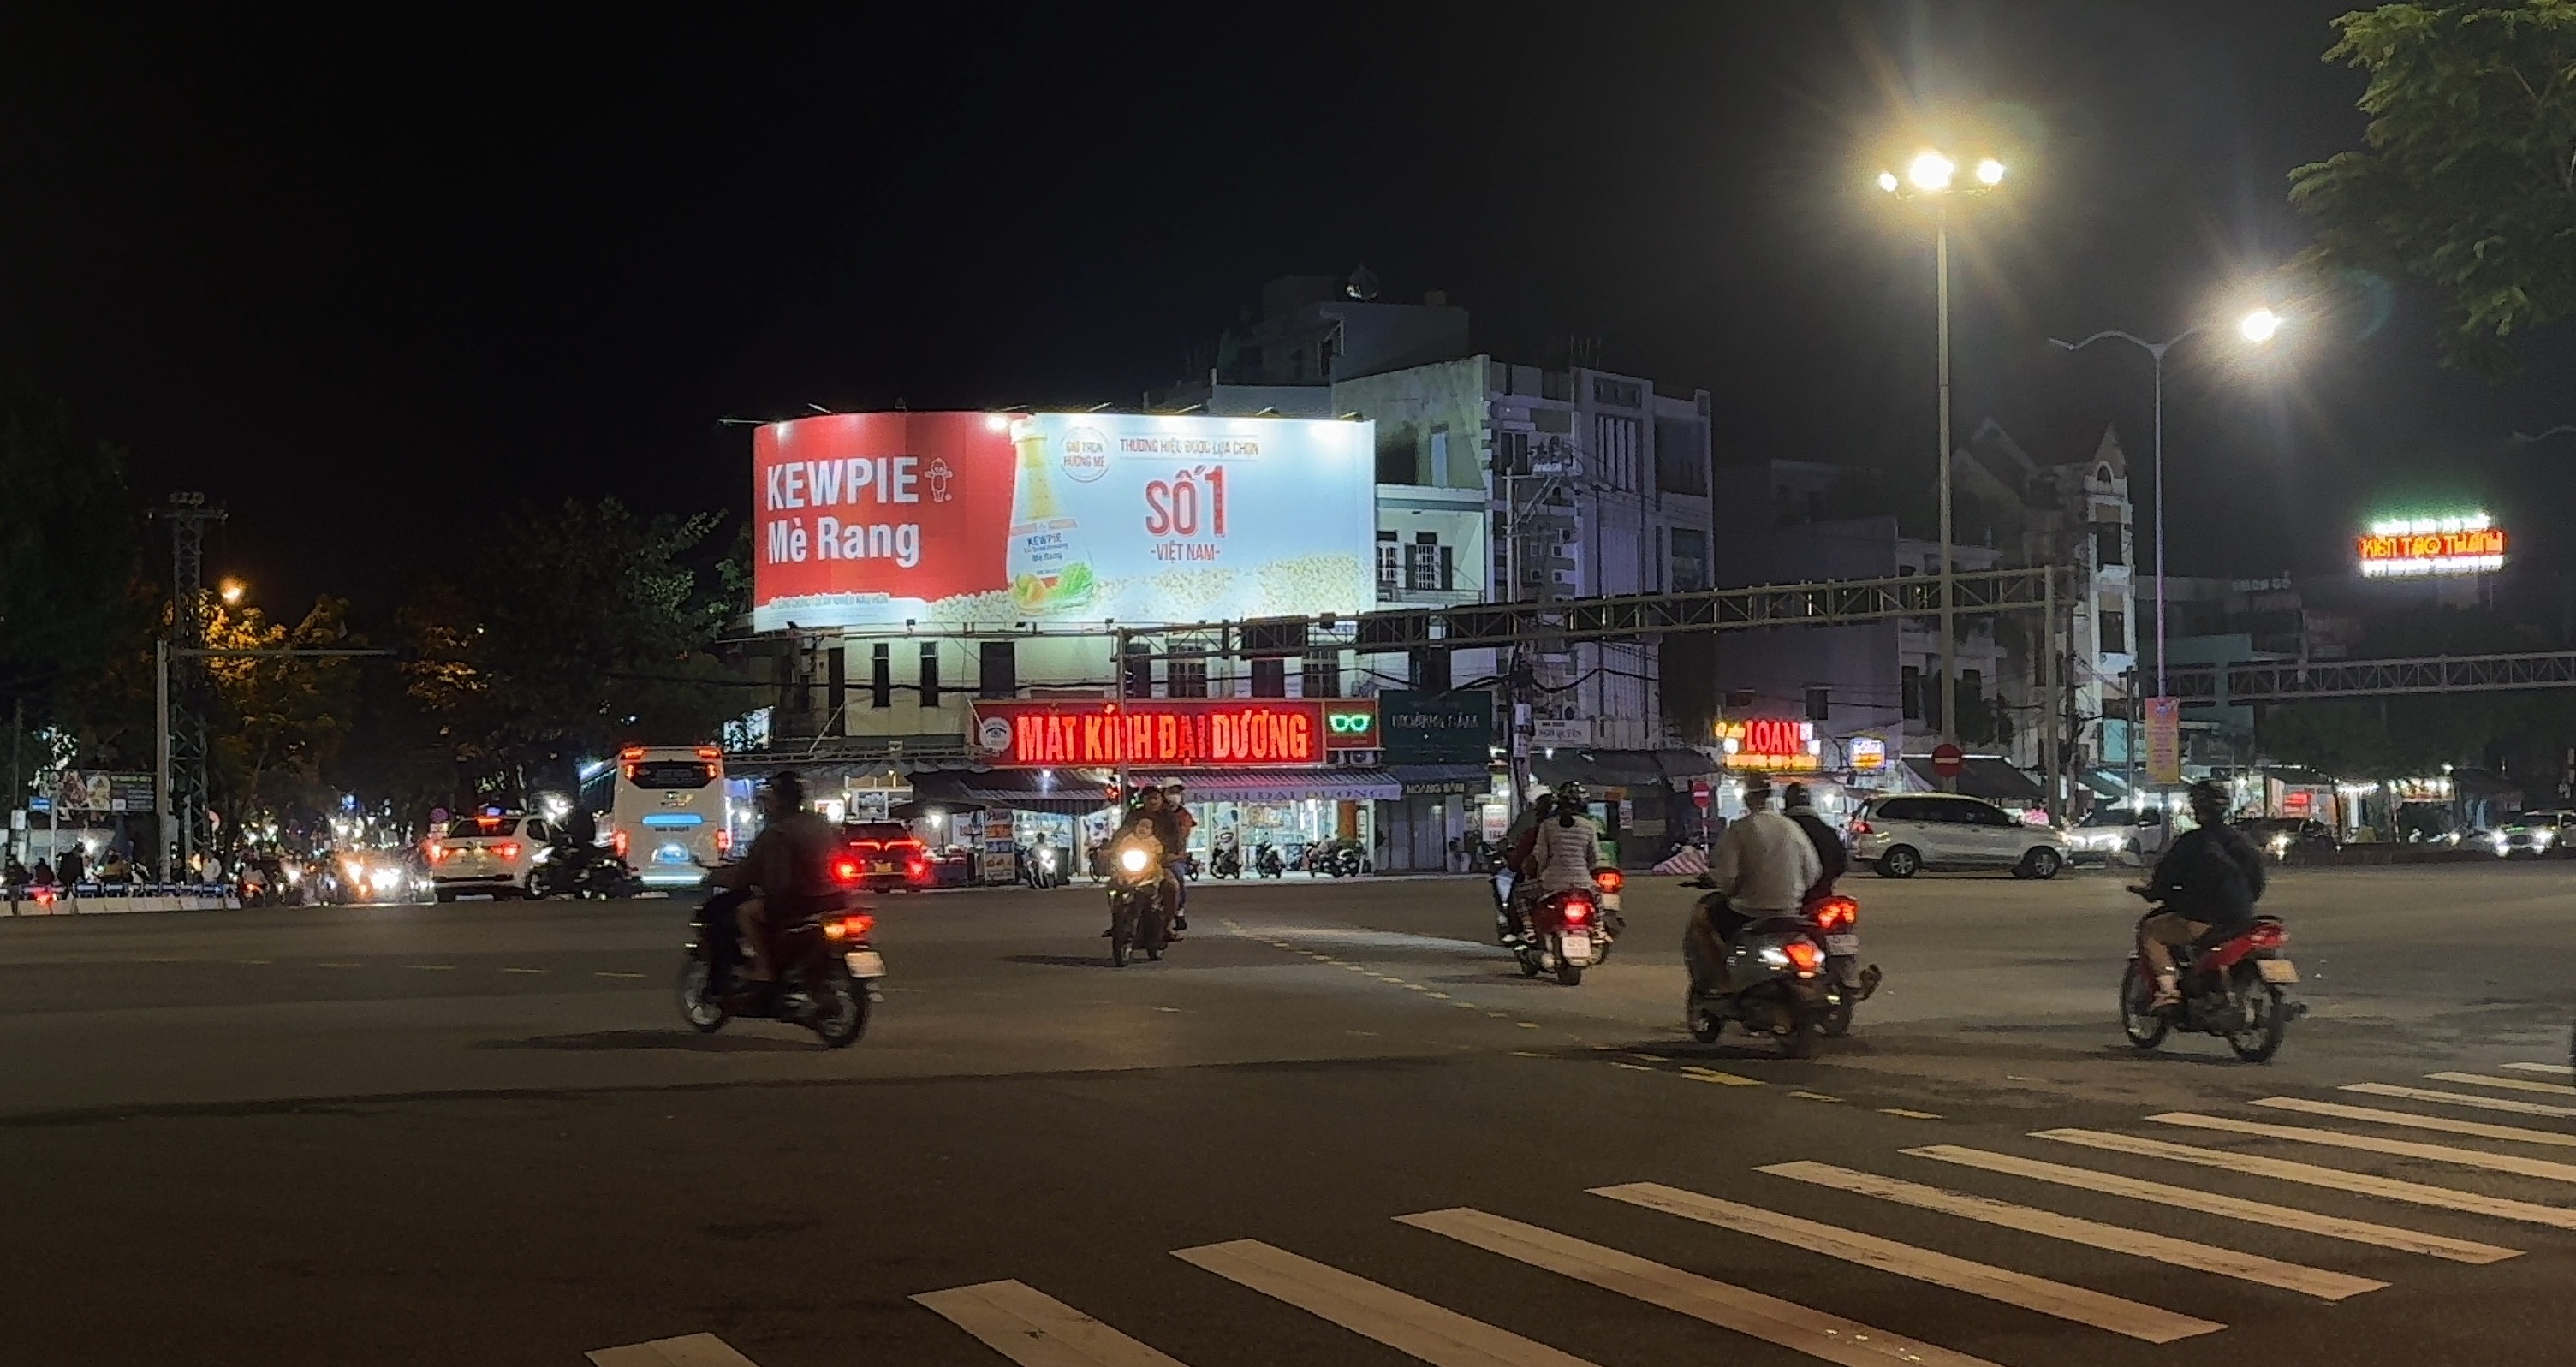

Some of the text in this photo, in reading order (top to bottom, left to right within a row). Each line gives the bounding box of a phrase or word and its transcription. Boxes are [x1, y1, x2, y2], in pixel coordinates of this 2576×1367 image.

[767, 456, 919, 511] KEWPIE
[1205, 465, 1224, 537] 1
[768, 516, 920, 568] Mè Rang
[1085, 703, 1152, 762] KÍNH
[1158, 714, 1206, 766] ĐẠI
[1211, 709, 1307, 759] DƯƠNG
[1746, 721, 1799, 754] LOAN
